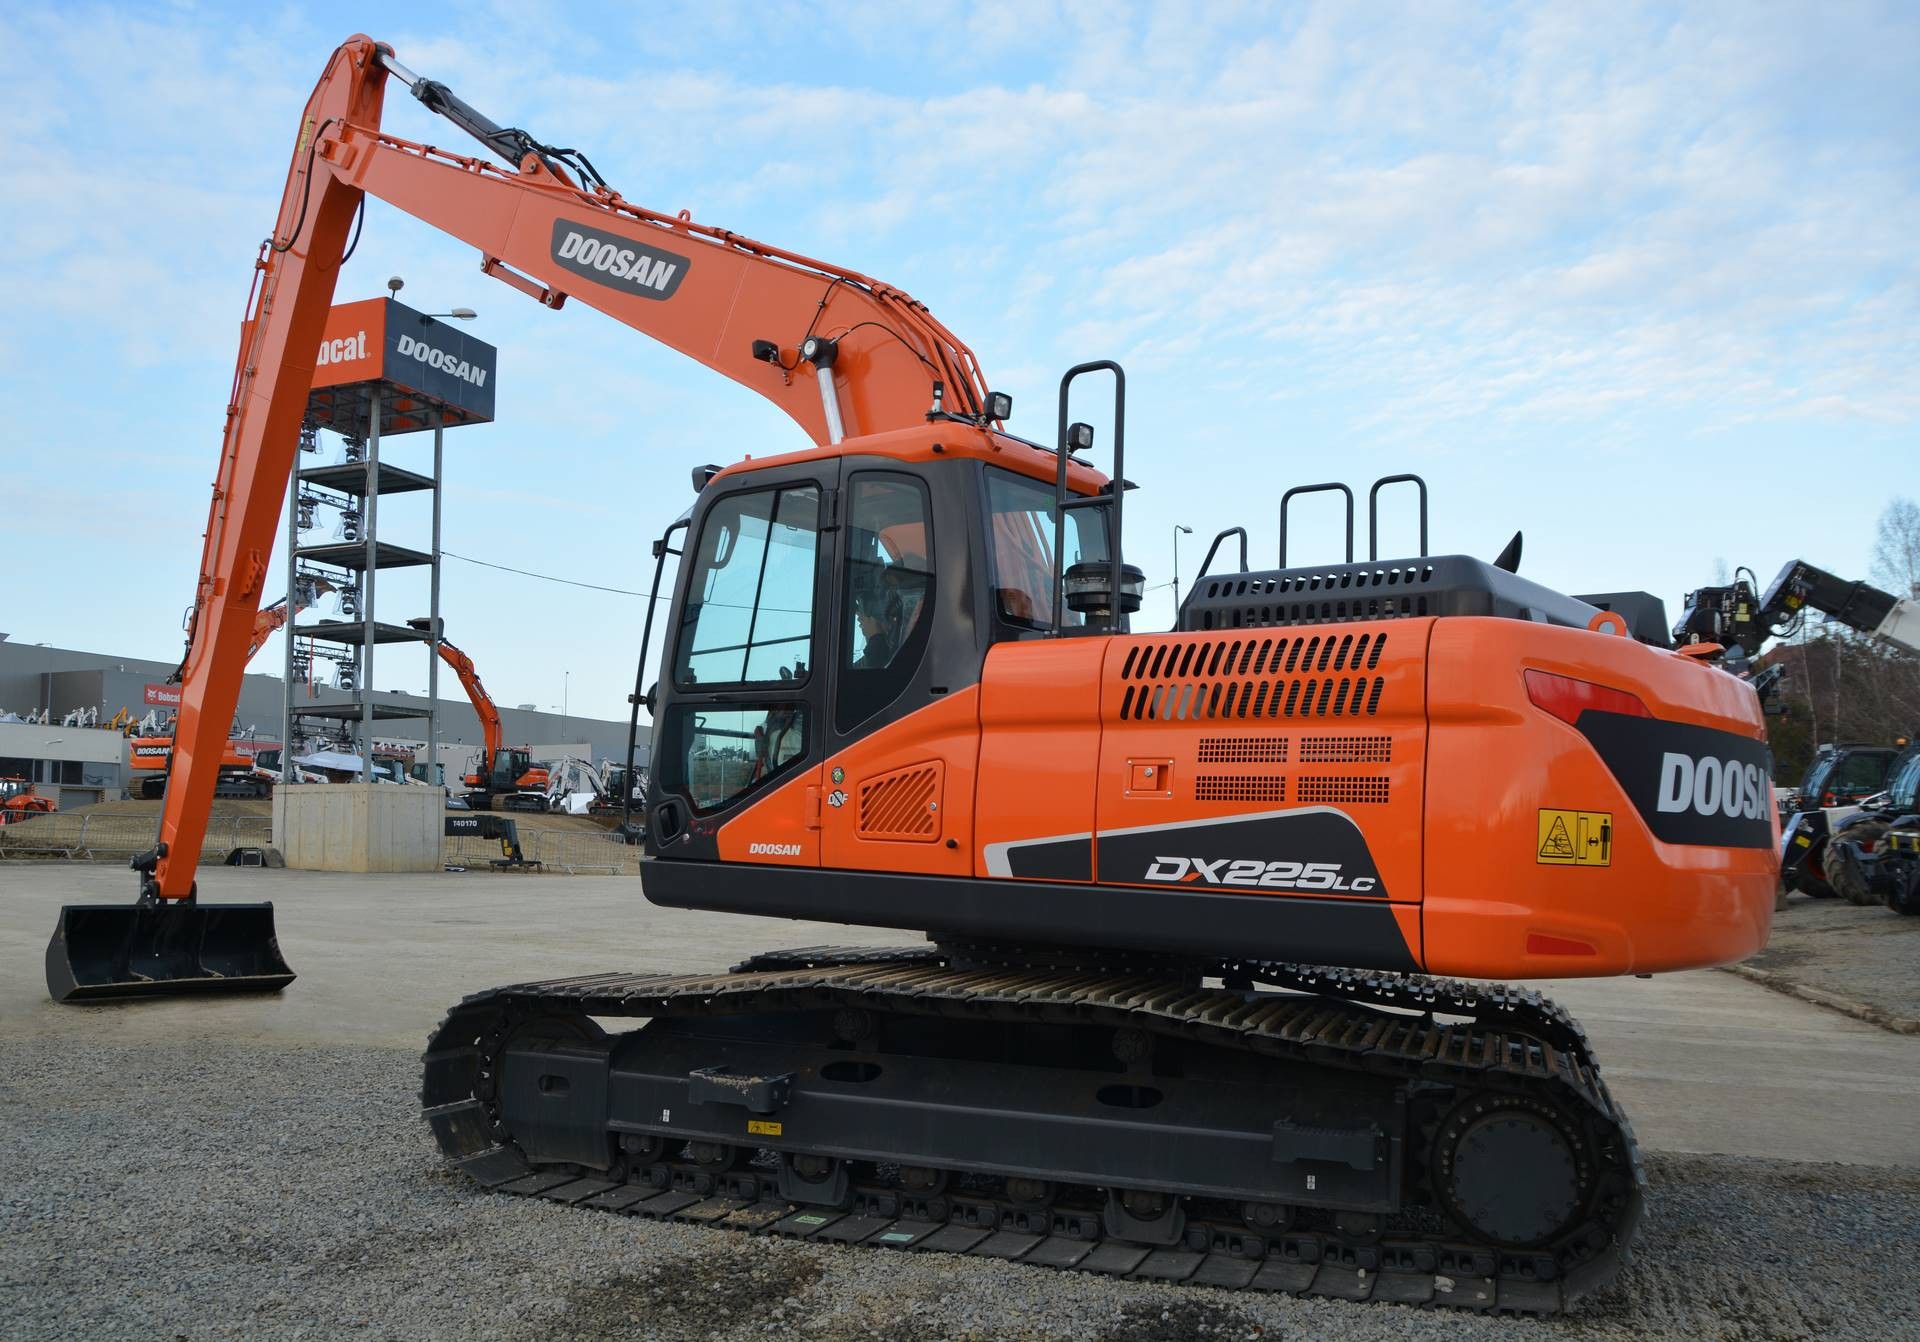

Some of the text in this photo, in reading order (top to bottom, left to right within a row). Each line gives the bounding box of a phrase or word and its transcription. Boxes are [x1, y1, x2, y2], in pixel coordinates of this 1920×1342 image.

[558, 231, 677, 291] DOOSAN
[396, 334, 487, 388] DOOSAN
[749, 843, 801, 856] DOOSAN
